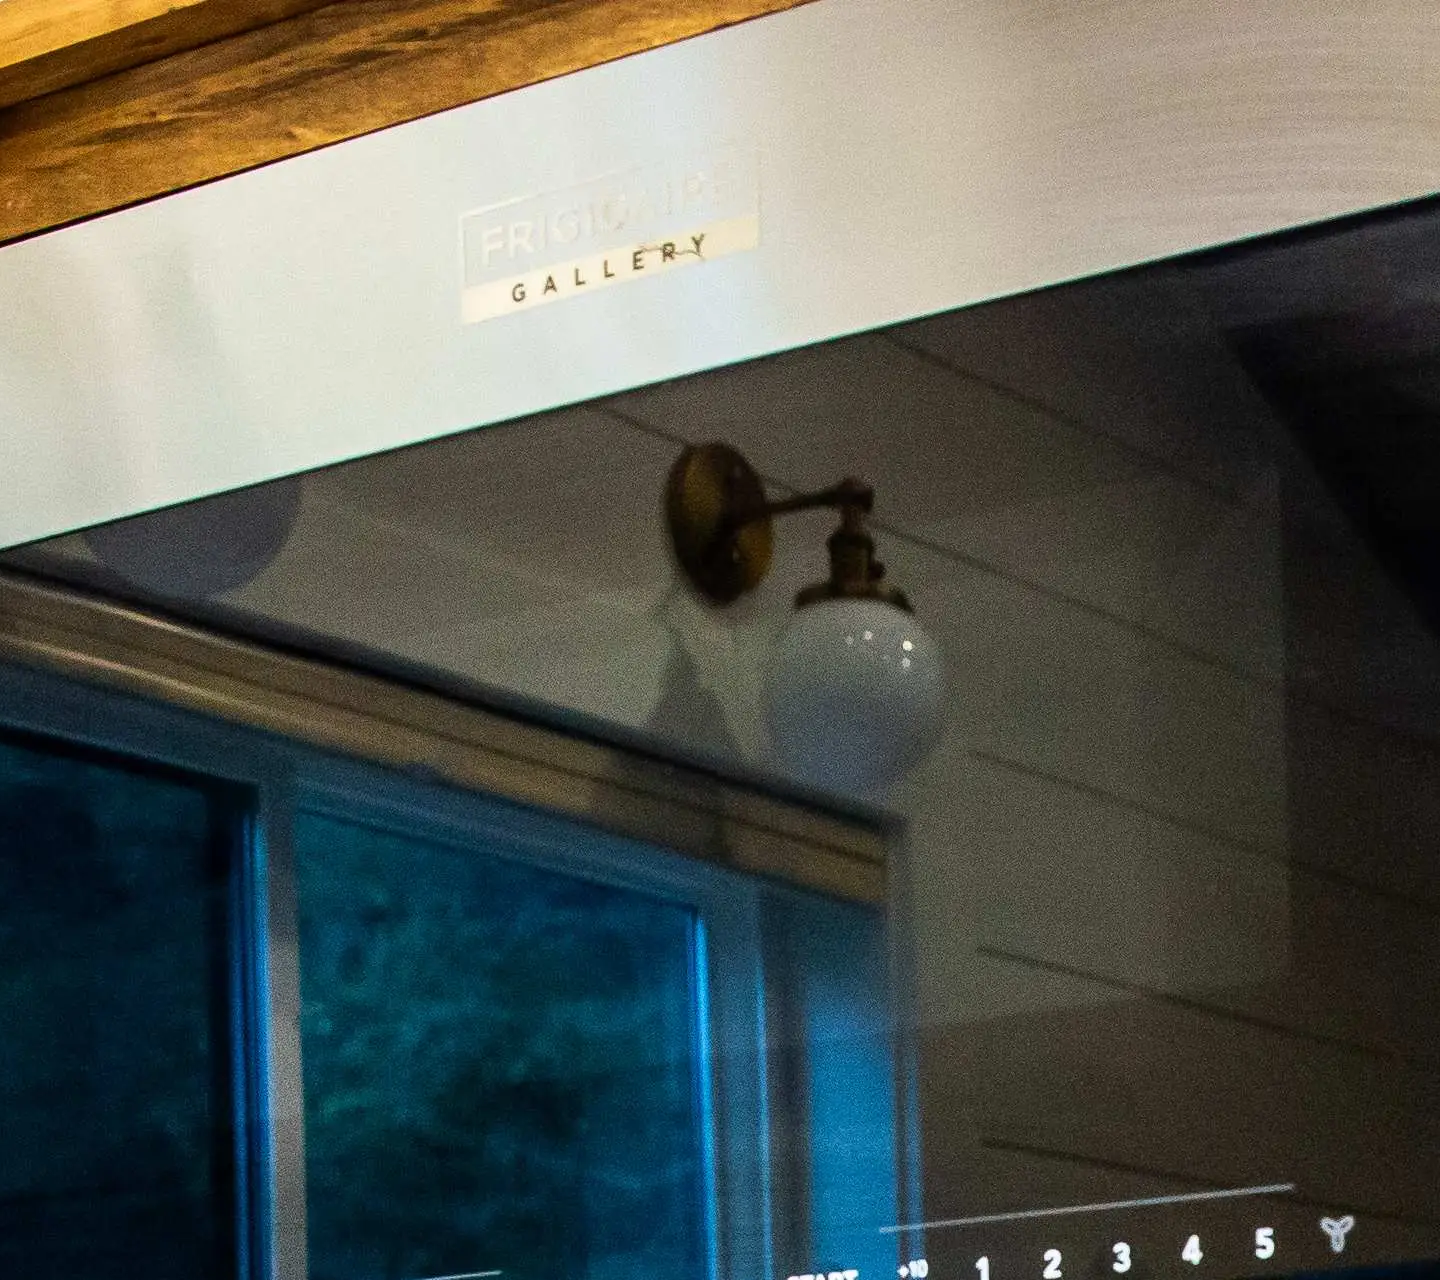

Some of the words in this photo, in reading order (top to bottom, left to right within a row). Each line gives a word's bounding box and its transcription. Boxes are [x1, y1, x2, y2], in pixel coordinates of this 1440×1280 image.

[511, 232, 706, 303] GALLERY
[1042, 1249, 1063, 1279] 2
[1111, 1241, 1132, 1273] 3
[1181, 1234, 1204, 1265] 4
[1254, 1226, 1275, 1259] 5
